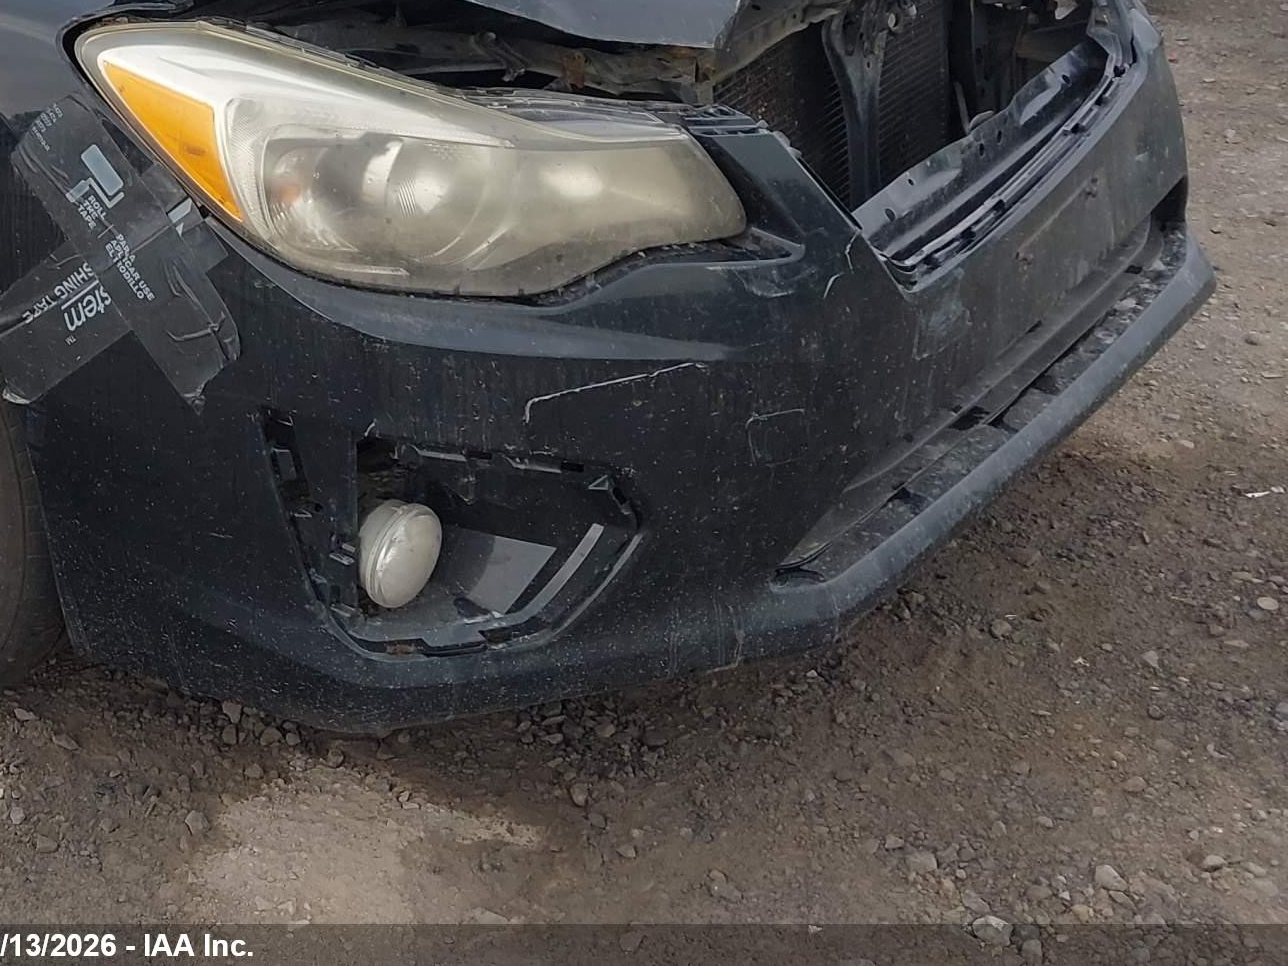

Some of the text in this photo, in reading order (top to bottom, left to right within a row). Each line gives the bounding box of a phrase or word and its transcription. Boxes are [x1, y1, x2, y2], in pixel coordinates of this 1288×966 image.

[78, 204, 97, 230] TAPE
[83, 200, 99, 221] THE
[88, 195, 106, 221] ROLL
[138, 280, 155, 301] USE
